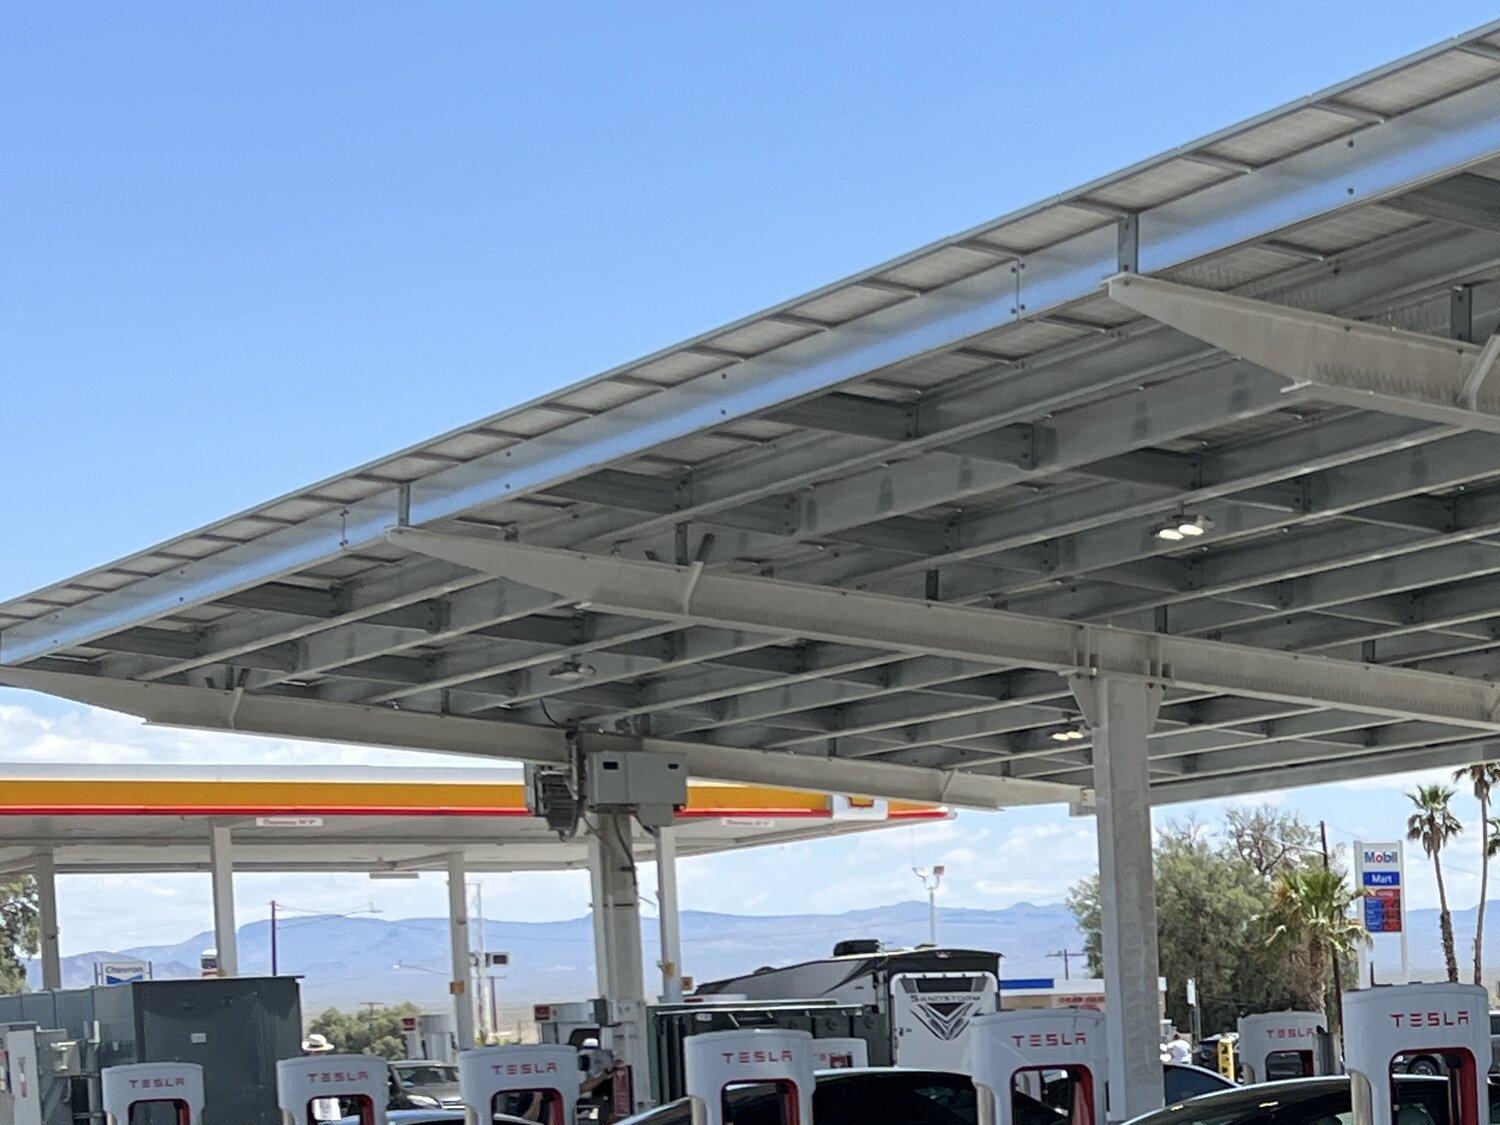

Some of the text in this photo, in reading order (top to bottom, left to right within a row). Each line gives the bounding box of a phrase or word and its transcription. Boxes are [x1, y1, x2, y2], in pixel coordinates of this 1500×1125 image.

[1364, 851, 1398, 864] Mobil
[1371, 874, 1393, 884] Mart
[1390, 1010, 1470, 1028] TESLA
[1011, 1032, 1087, 1048] TESLA
[1266, 1027, 1316, 1039] TESLA
[721, 1050, 794, 1064] TESLA
[491, 1062, 558, 1076] TESLA
[128, 1076, 185, 1090] TESLA
[307, 1070, 370, 1084] TESLA
